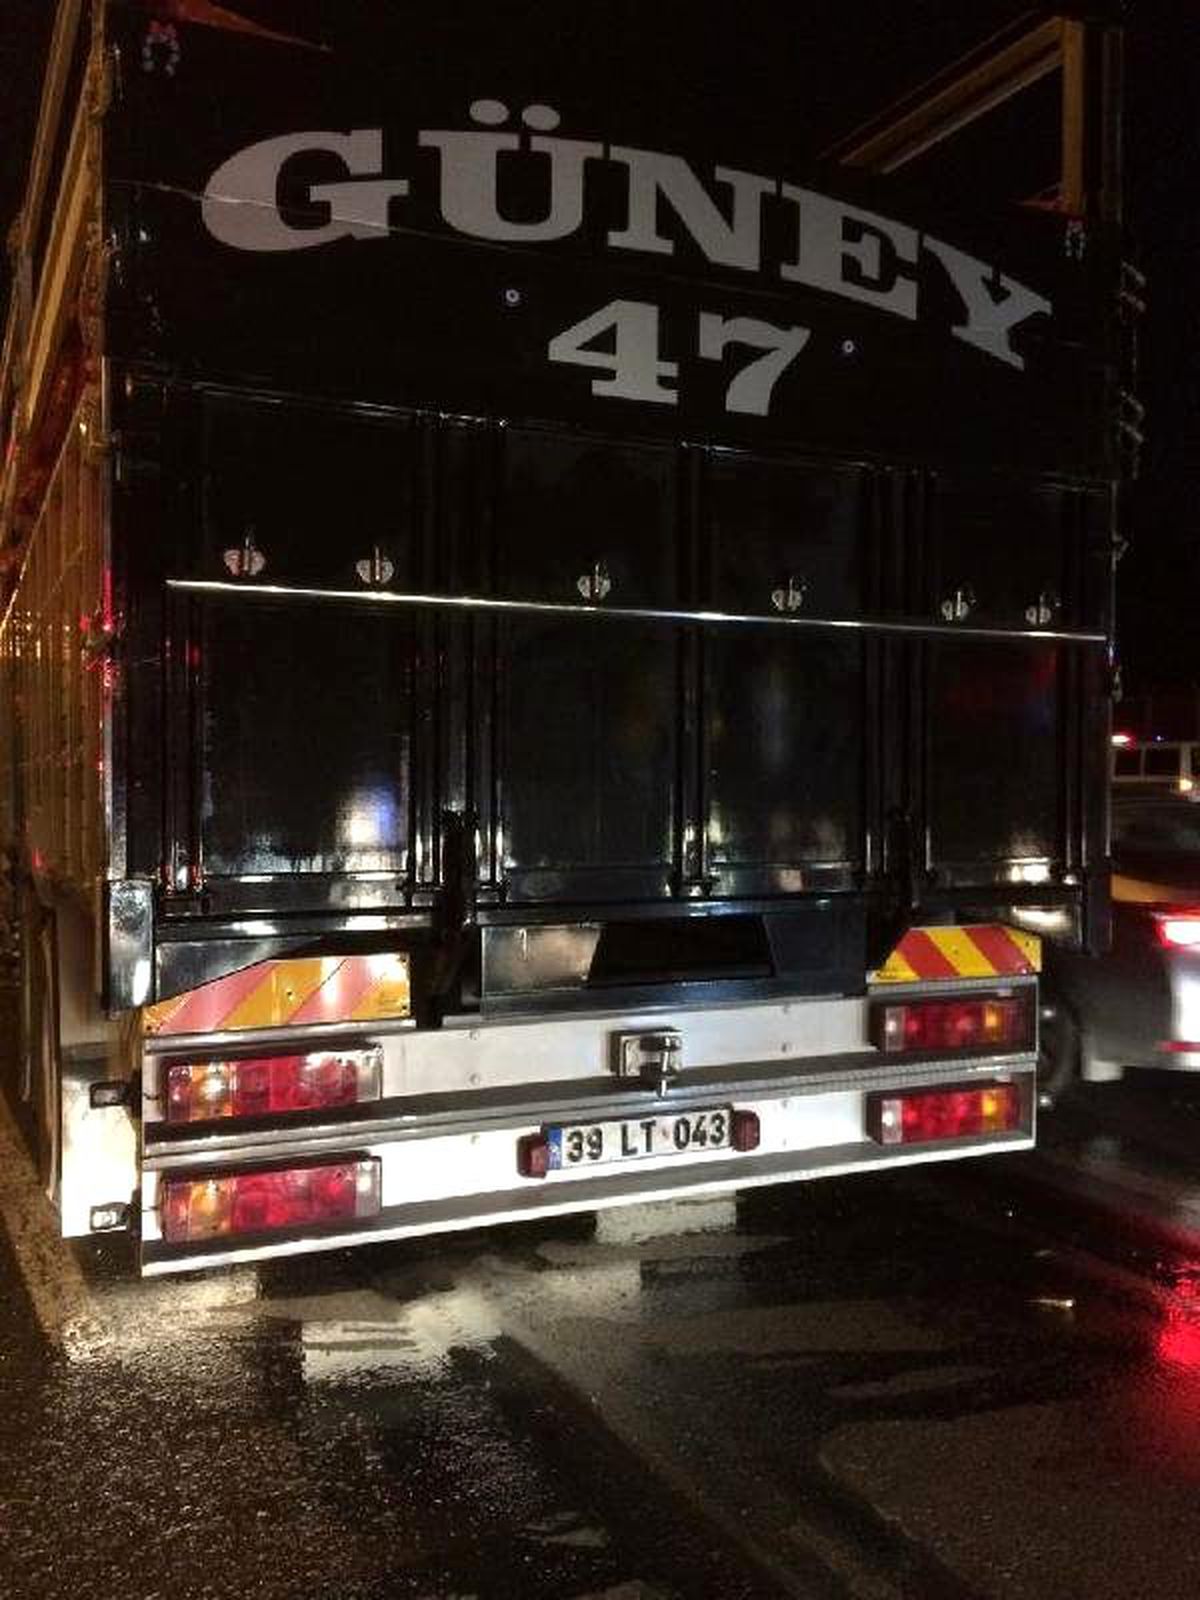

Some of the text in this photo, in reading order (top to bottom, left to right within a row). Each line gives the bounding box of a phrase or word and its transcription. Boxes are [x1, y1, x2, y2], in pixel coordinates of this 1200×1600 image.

[200, 99, 1053, 371] GÜNEY
[548, 299, 811, 415] 47
[566, 1128, 603, 1162] 39
[620, 1119, 656, 1156] LT
[673, 1112, 726, 1150] 043
